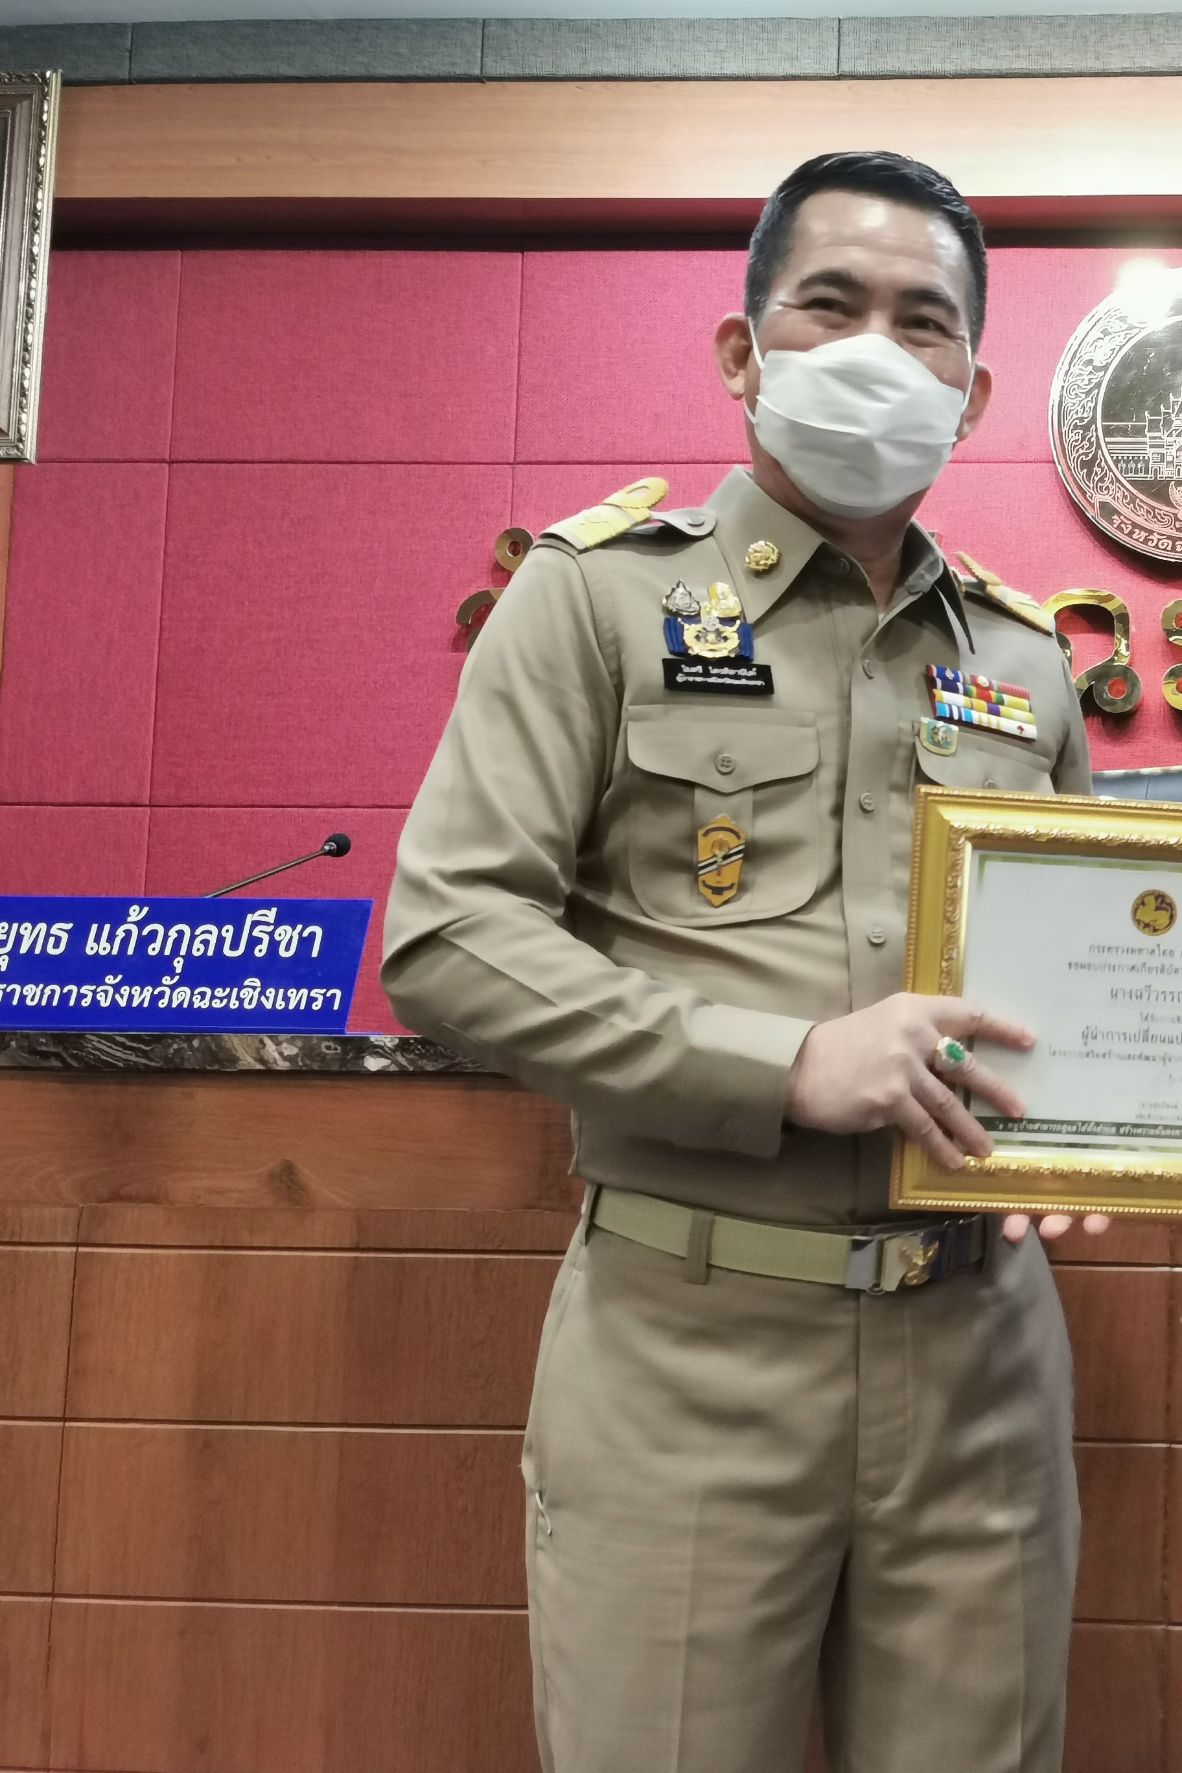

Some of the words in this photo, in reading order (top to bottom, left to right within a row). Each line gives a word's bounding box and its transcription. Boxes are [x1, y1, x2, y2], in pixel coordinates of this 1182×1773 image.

[85, 904, 324, 973] แก้วกุลปรีชา
